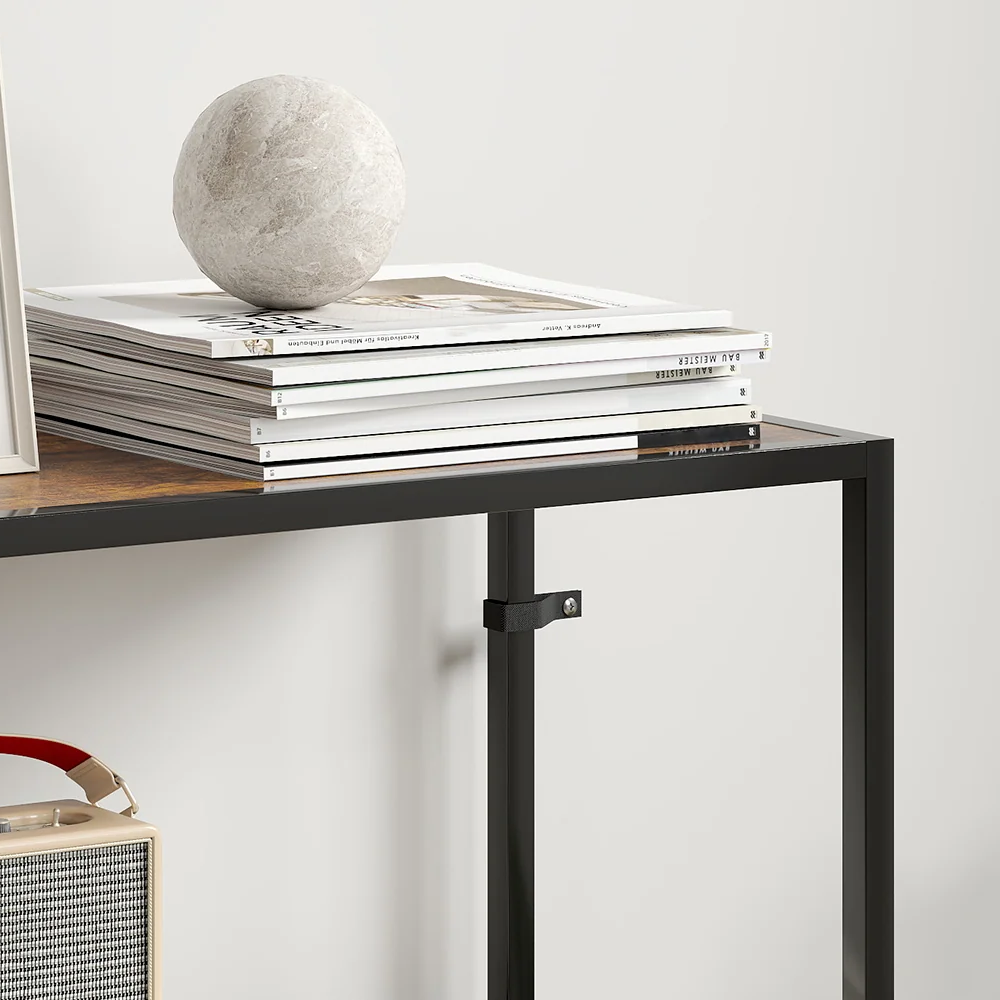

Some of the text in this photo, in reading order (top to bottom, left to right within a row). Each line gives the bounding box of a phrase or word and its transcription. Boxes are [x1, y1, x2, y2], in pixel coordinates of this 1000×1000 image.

[376, 334, 420, 343] Kreativatlas
[678, 352, 741, 366] BAU MEISTER
[655, 366, 713, 379] BAU MEISTER
